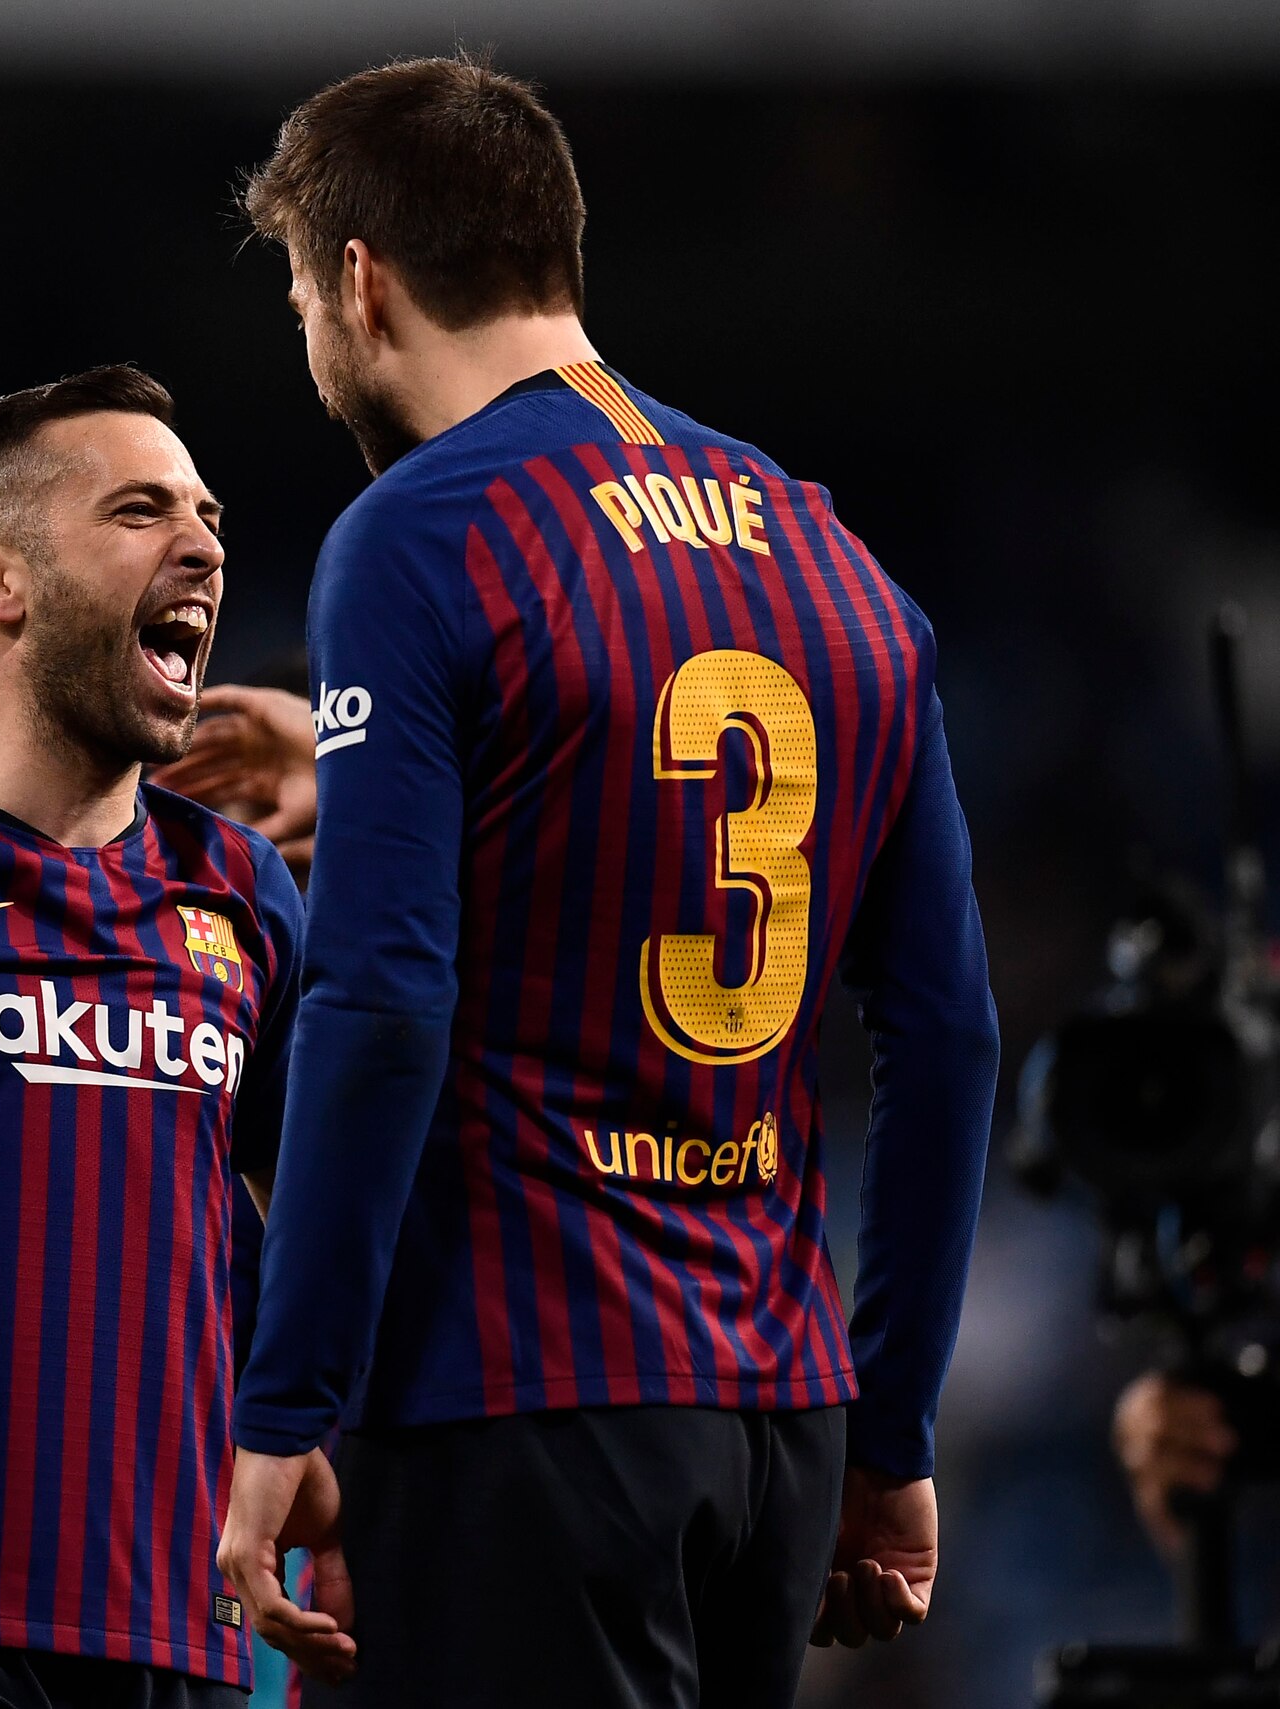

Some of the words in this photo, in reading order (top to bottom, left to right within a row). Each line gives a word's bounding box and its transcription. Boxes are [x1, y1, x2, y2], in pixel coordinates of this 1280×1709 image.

[589, 473, 770, 556] PIQUÉ
[312, 681, 372, 742] ko
[639, 649, 817, 1065] 3
[584, 1120, 762, 1185] unicef
